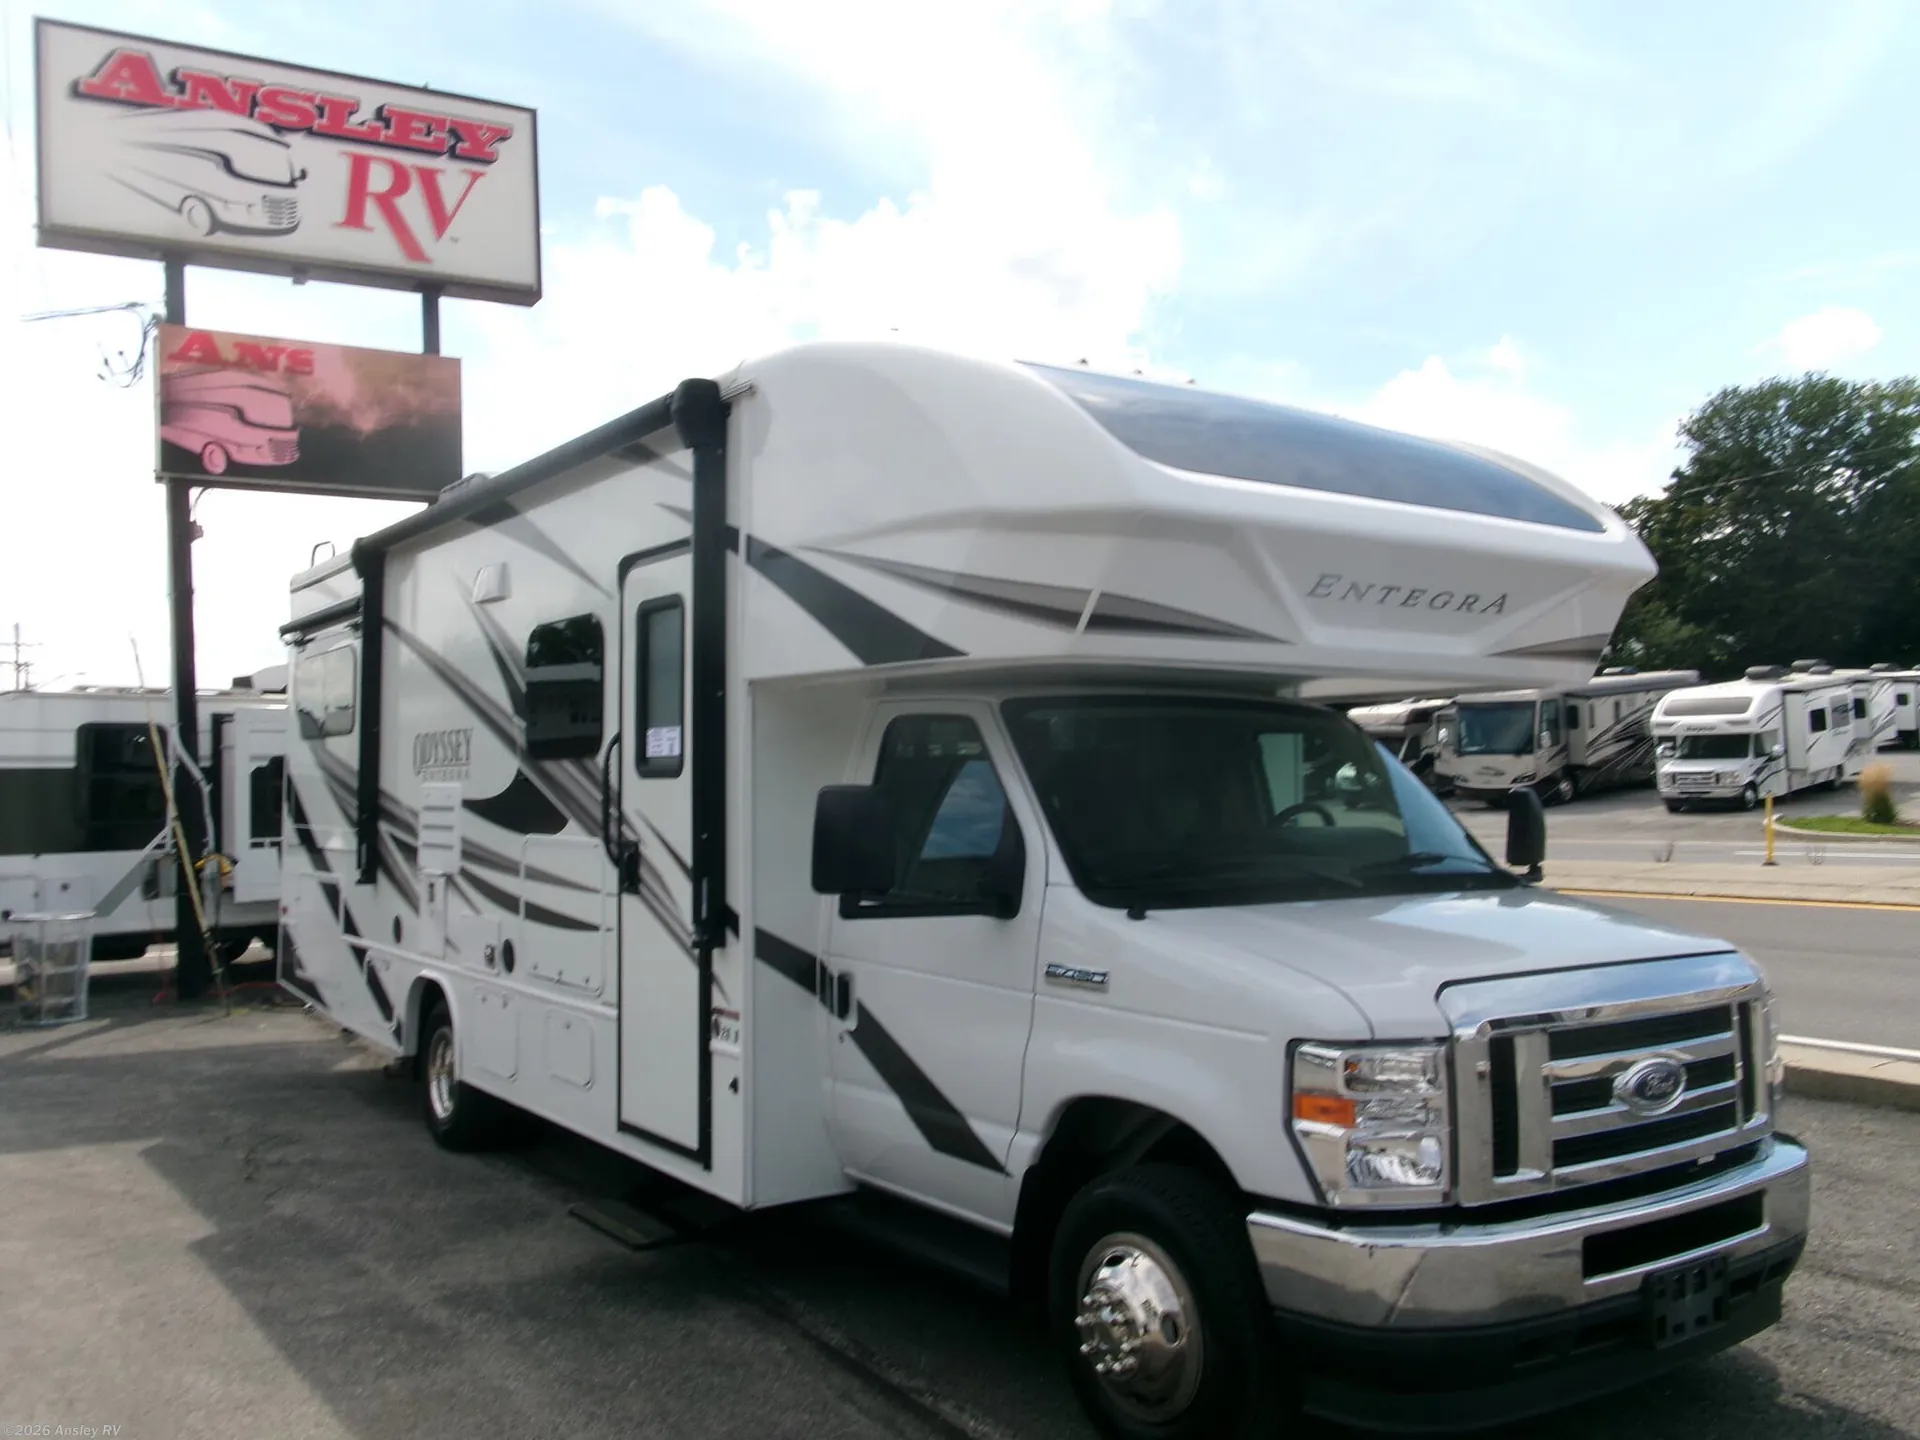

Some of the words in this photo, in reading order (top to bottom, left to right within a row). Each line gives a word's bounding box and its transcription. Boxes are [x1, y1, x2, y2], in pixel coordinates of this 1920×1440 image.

[74, 48, 514, 164] ANSLEY
[332, 150, 486, 264] RV
[1306, 572, 1510, 614] ENTEGRA
[412, 725, 475, 777] ODYSSEY
